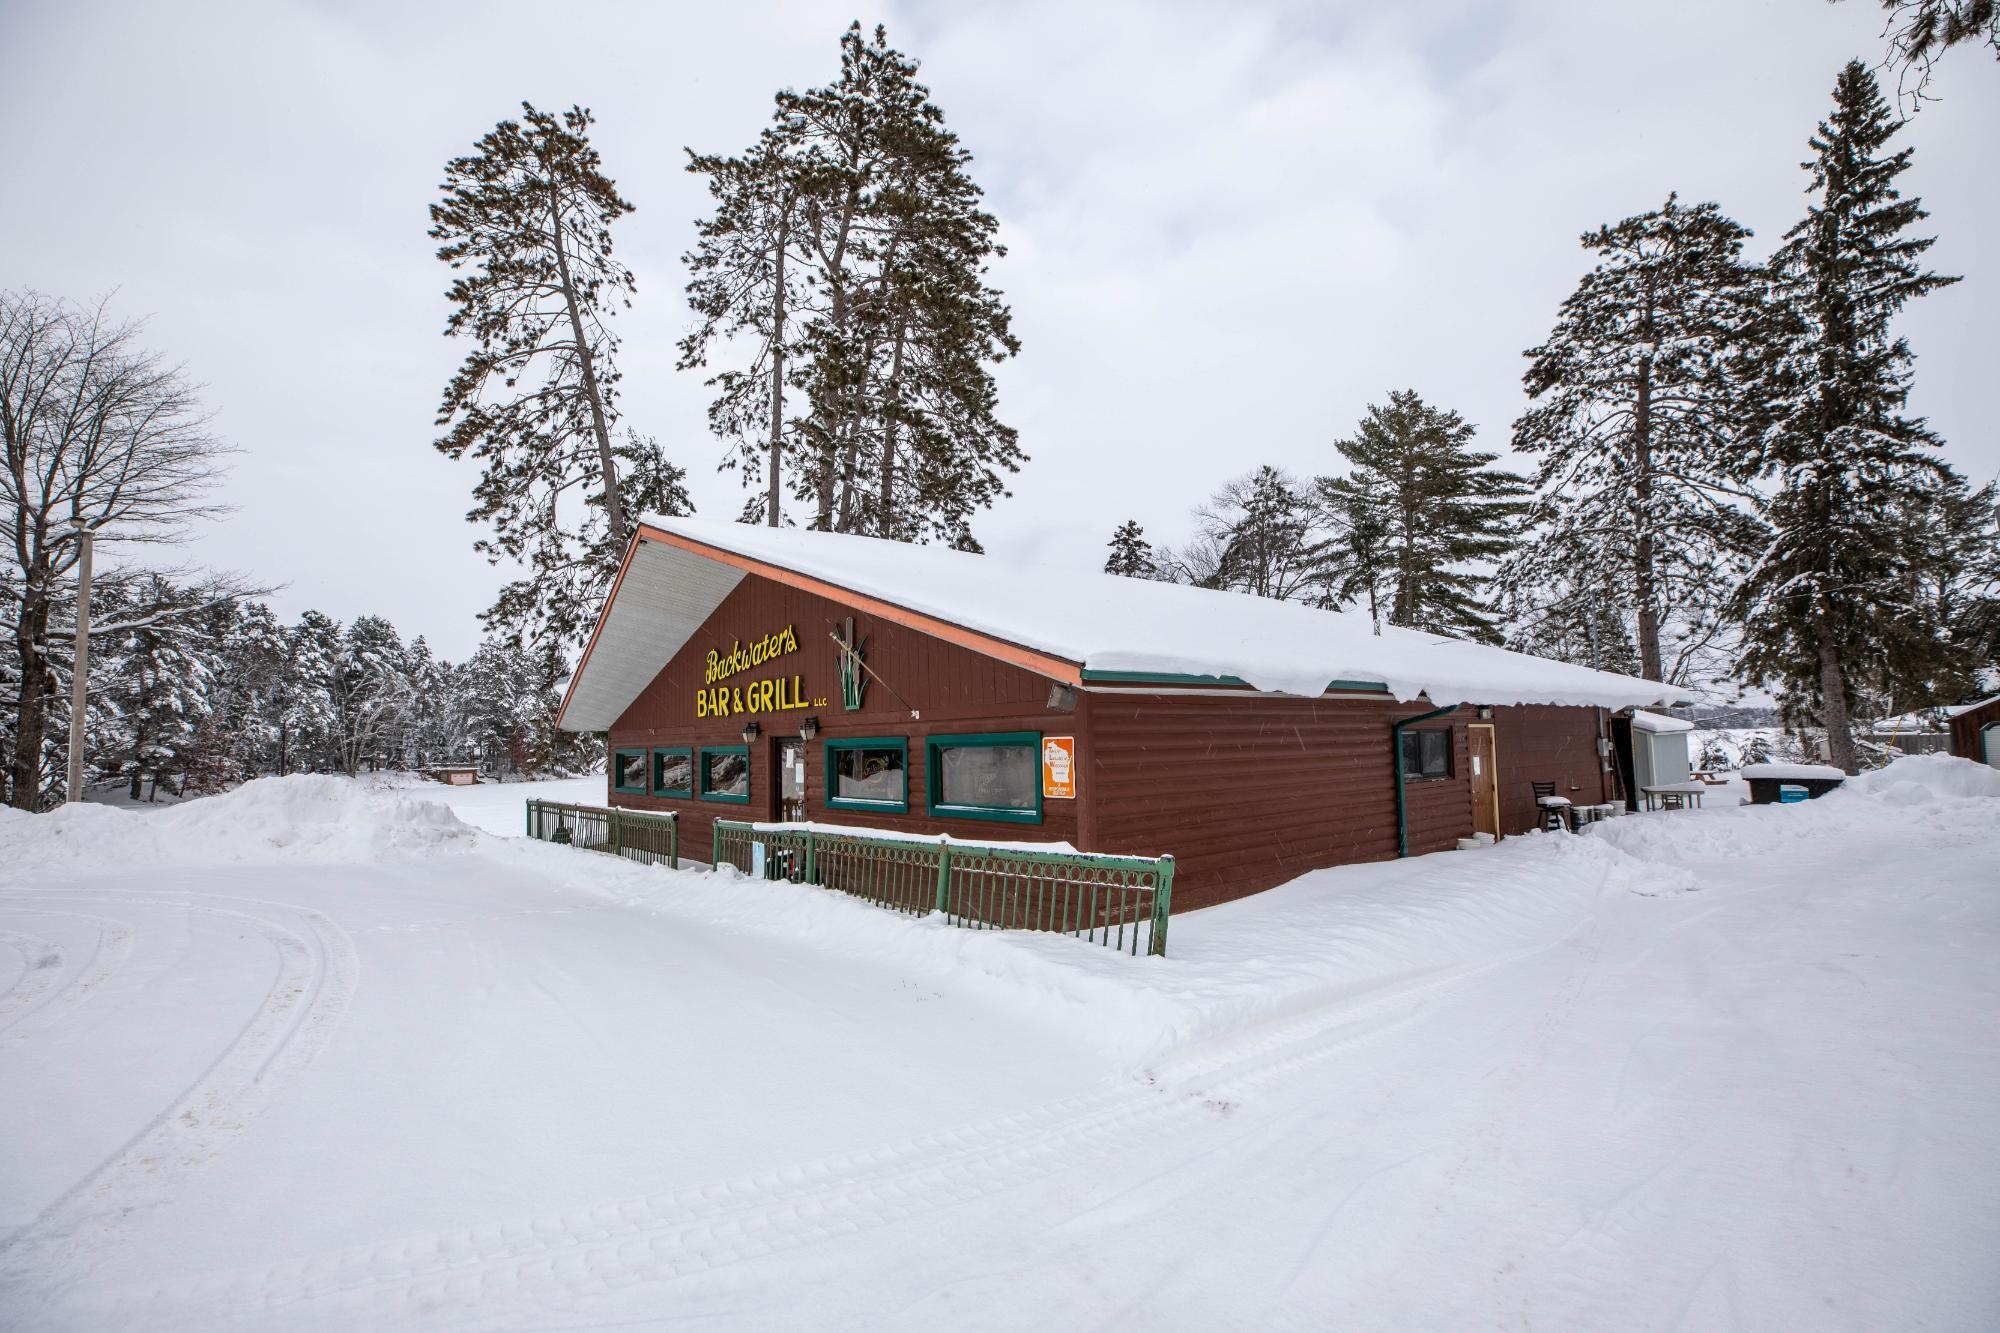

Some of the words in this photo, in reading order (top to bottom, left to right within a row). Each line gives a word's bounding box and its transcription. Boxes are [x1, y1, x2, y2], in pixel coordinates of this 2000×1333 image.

[705, 624, 798, 685] Backwaters
[697, 686, 730, 718] BAR
[733, 687, 745, 713] &
[747, 675, 810, 714] GRILL
[814, 697, 828, 707] LLC
